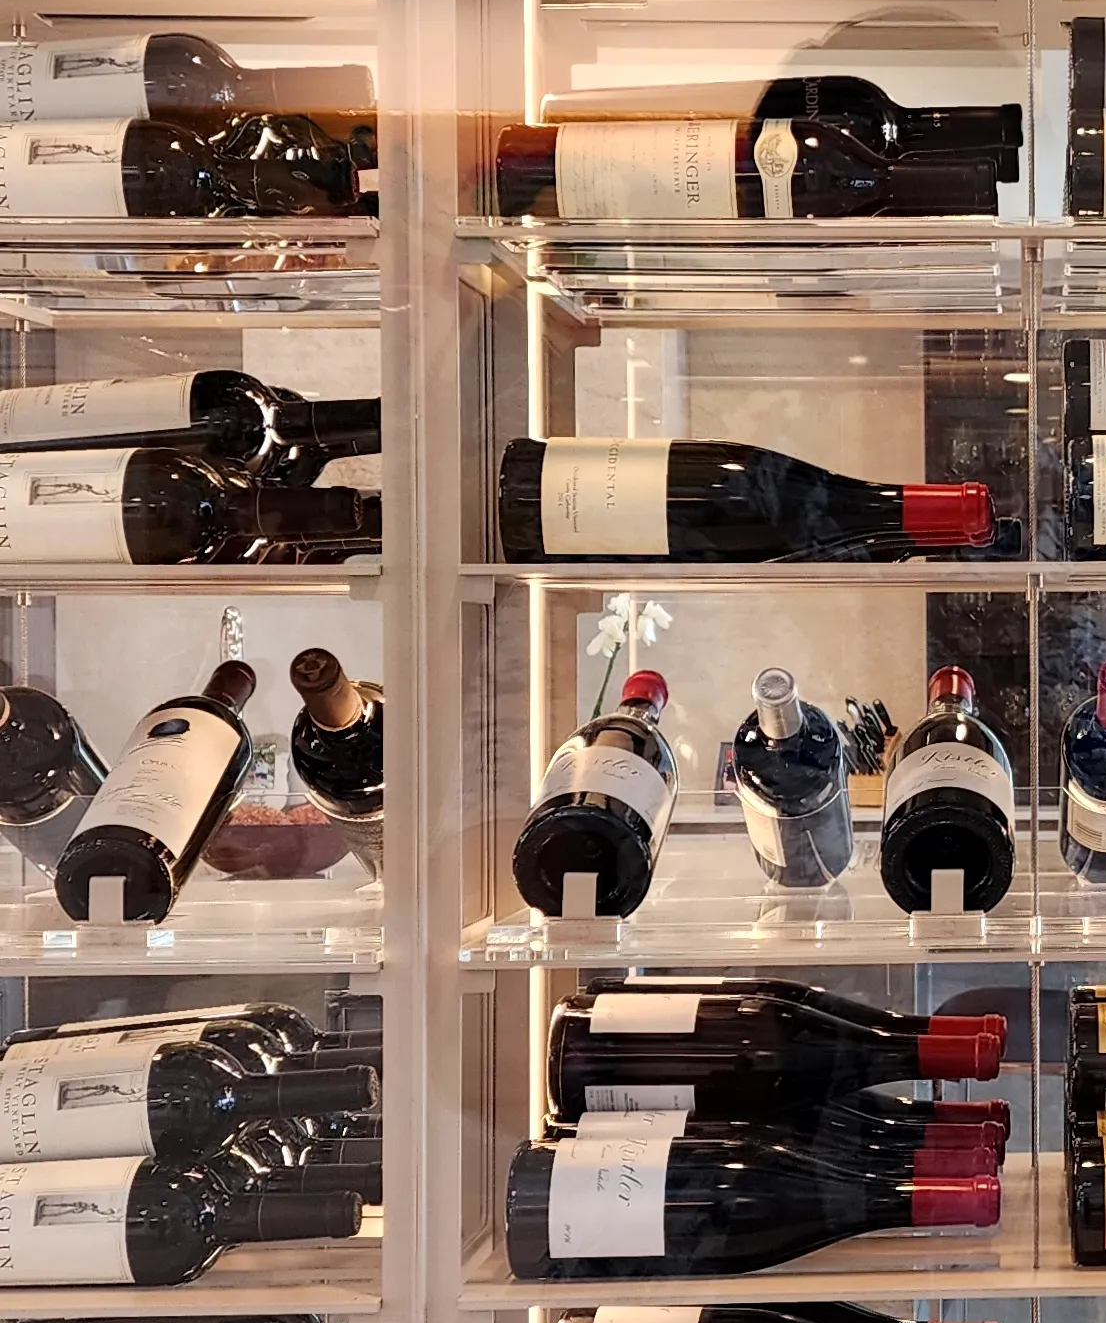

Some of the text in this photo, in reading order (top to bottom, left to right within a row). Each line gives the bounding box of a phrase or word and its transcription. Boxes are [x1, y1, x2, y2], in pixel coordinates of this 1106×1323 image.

[17, 43, 38, 120] TAGLIN
[803, 77, 821, 120] CARDIN
[21, 1058, 49, 1154] STAGLIN
[618, 1139, 648, 1207] Kistler
